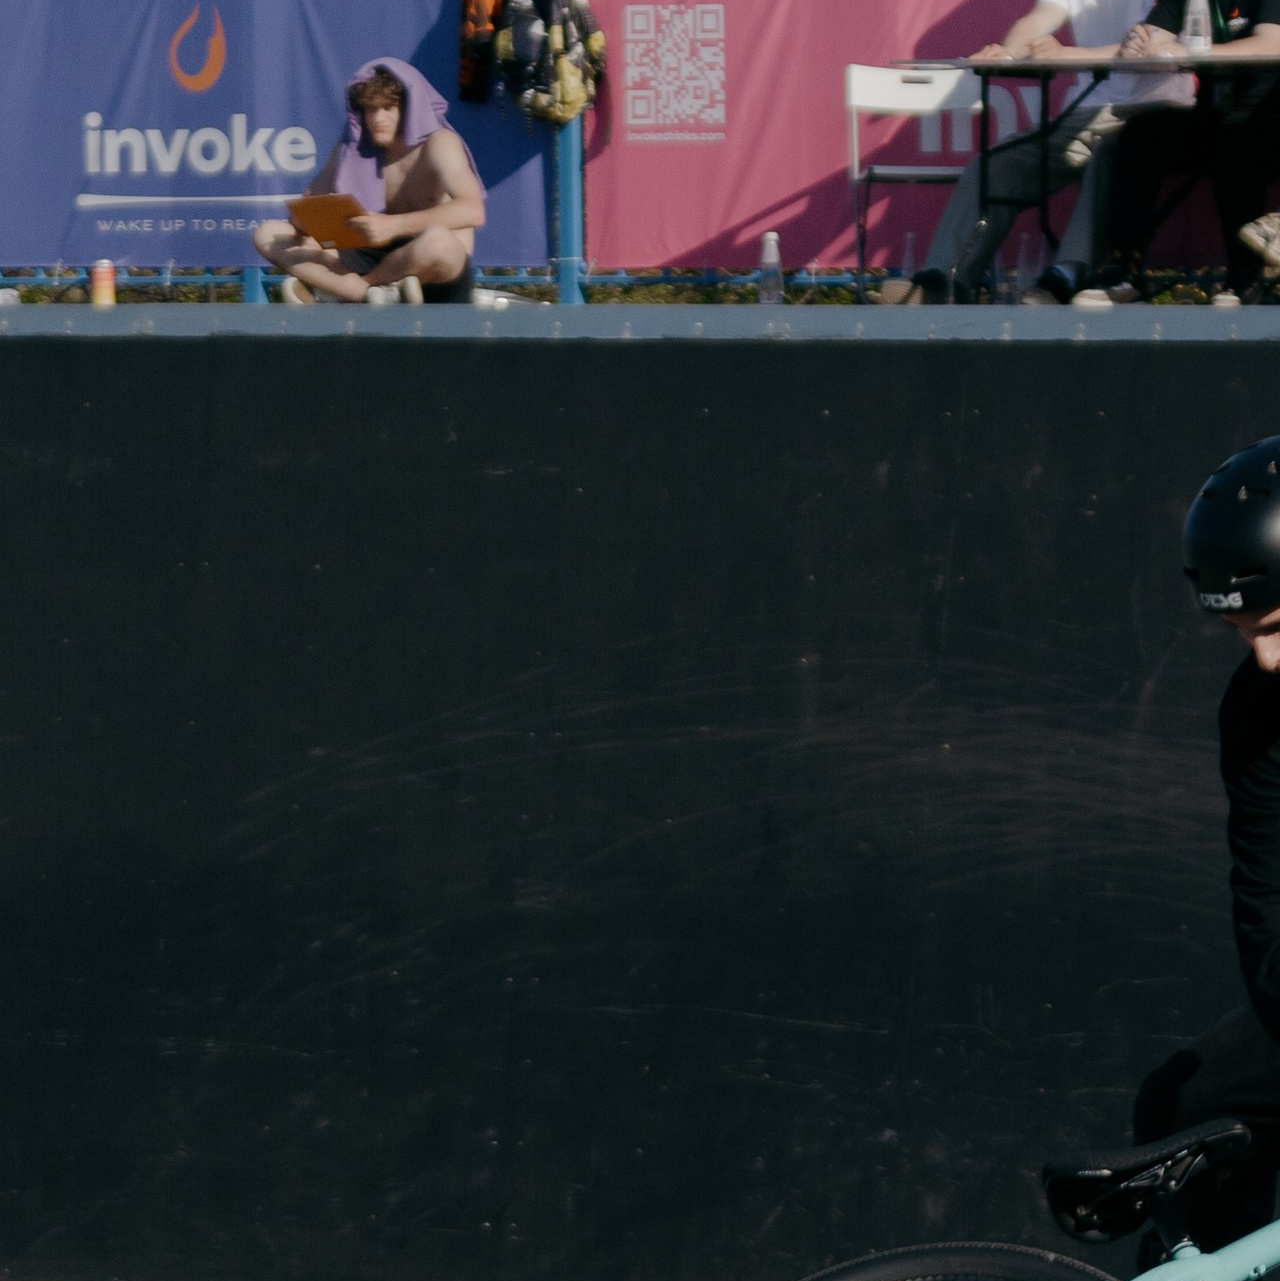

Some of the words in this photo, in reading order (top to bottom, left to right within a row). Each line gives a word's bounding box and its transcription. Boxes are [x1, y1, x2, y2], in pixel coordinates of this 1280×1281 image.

[84, 111, 317, 173] invoke
[98, 219, 154, 232] WAKE
[161, 219, 186, 232] UP
[193, 219, 217, 232] TO
